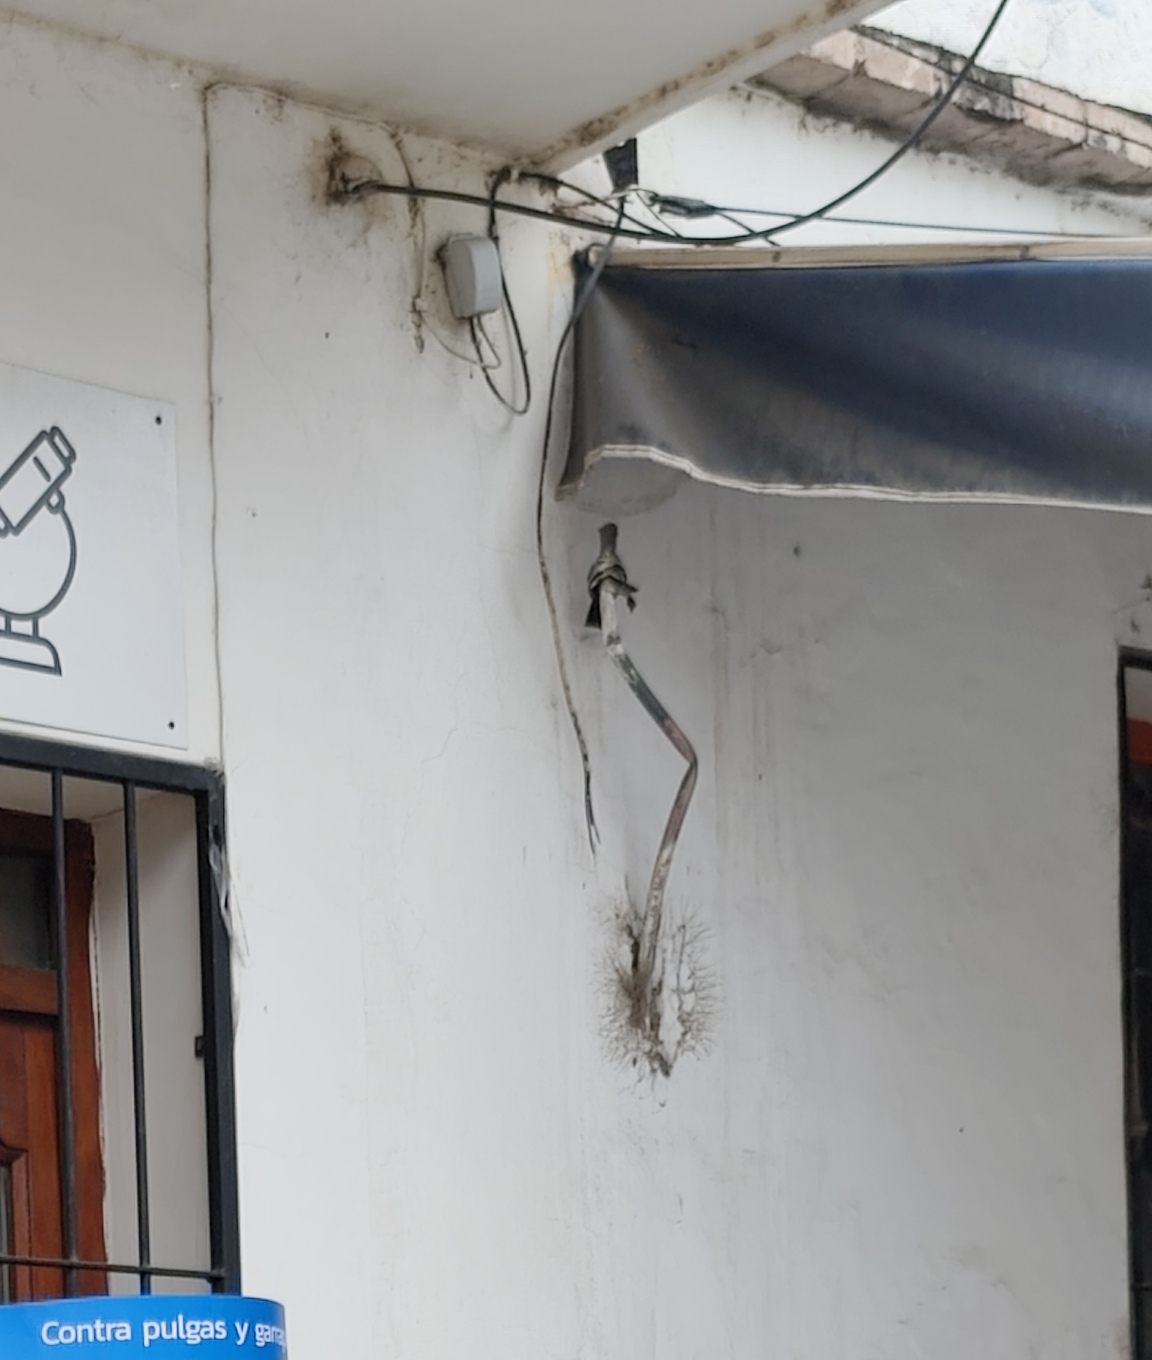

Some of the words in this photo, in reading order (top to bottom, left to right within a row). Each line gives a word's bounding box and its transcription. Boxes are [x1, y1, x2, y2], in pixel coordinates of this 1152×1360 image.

[41, 1318, 132, 1345] Contra
[143, 1313, 228, 1348] pulgas
[235, 1321, 249, 1345] y
